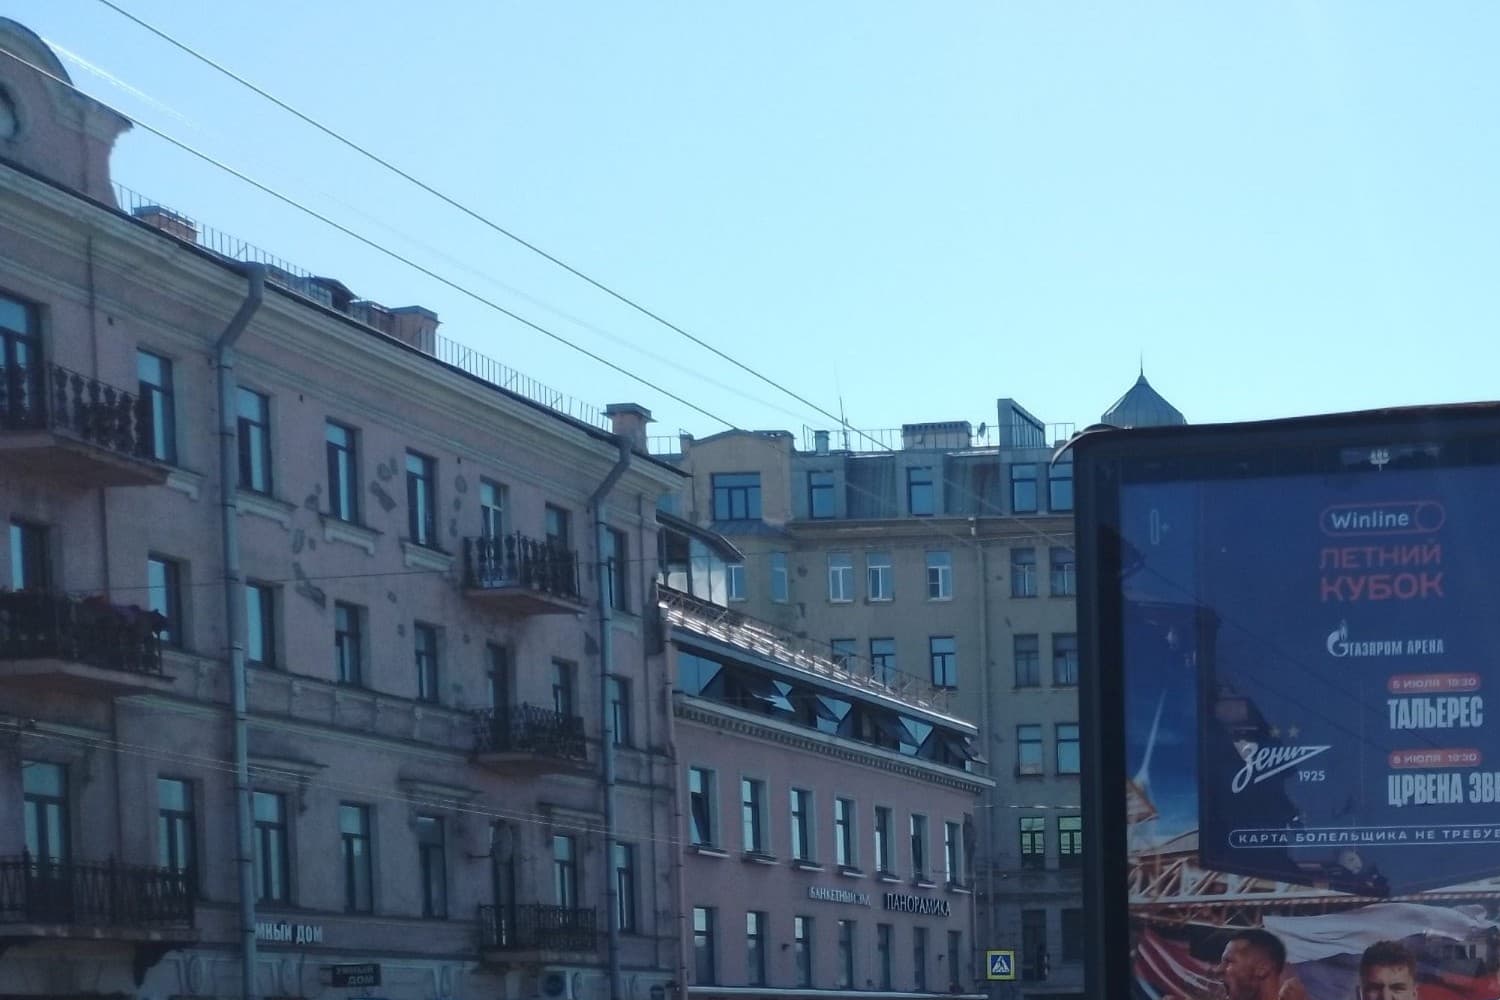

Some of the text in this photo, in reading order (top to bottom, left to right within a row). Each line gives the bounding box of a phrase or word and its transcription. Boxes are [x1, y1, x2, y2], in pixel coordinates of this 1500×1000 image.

[1331, 510, 1410, 529] Winline
[1319, 539, 1442, 569] ЛЕТНИЙ
[1320, 572, 1445, 603] КУБОК
[1349, 639, 1444, 656] ГАЗПРОМ АРЕНА
[1387, 696, 1484, 730] ТАЛЬЕРЕС
[1298, 770, 1326, 782] 1925
[1387, 773, 1464, 807] ЦРВЕНА
[1238, 833, 1289, 844] КАРТА
[1295, 830, 1408, 843] БОЛЕЛЬЩИКА
[1415, 829, 1436, 840] НЕ
[886, 893, 952, 917] ПАНОРАМИКА
[255, 921, 323, 944] МНЫЙ ДОМ
[347, 975, 374, 985] ДОМ
